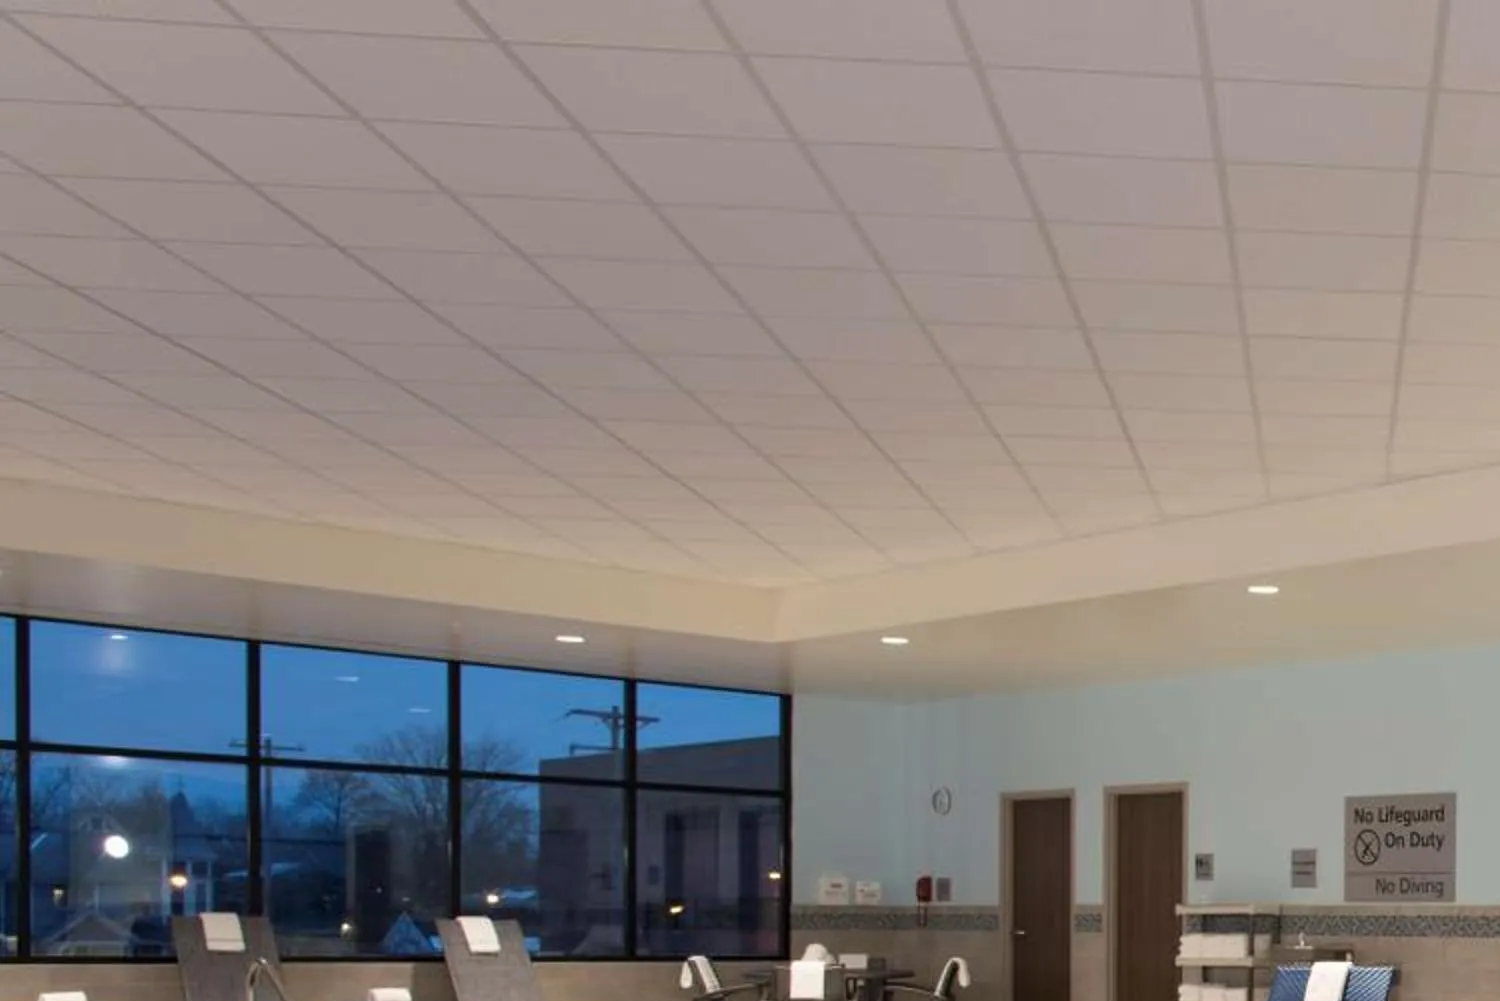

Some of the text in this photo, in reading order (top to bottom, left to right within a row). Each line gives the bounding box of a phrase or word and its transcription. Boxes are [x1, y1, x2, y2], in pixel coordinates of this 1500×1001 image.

[1353, 804, 1446, 827] No Lifeguard
[1384, 831, 1445, 852] On Duty
[1375, 877, 1444, 898] No Diving
